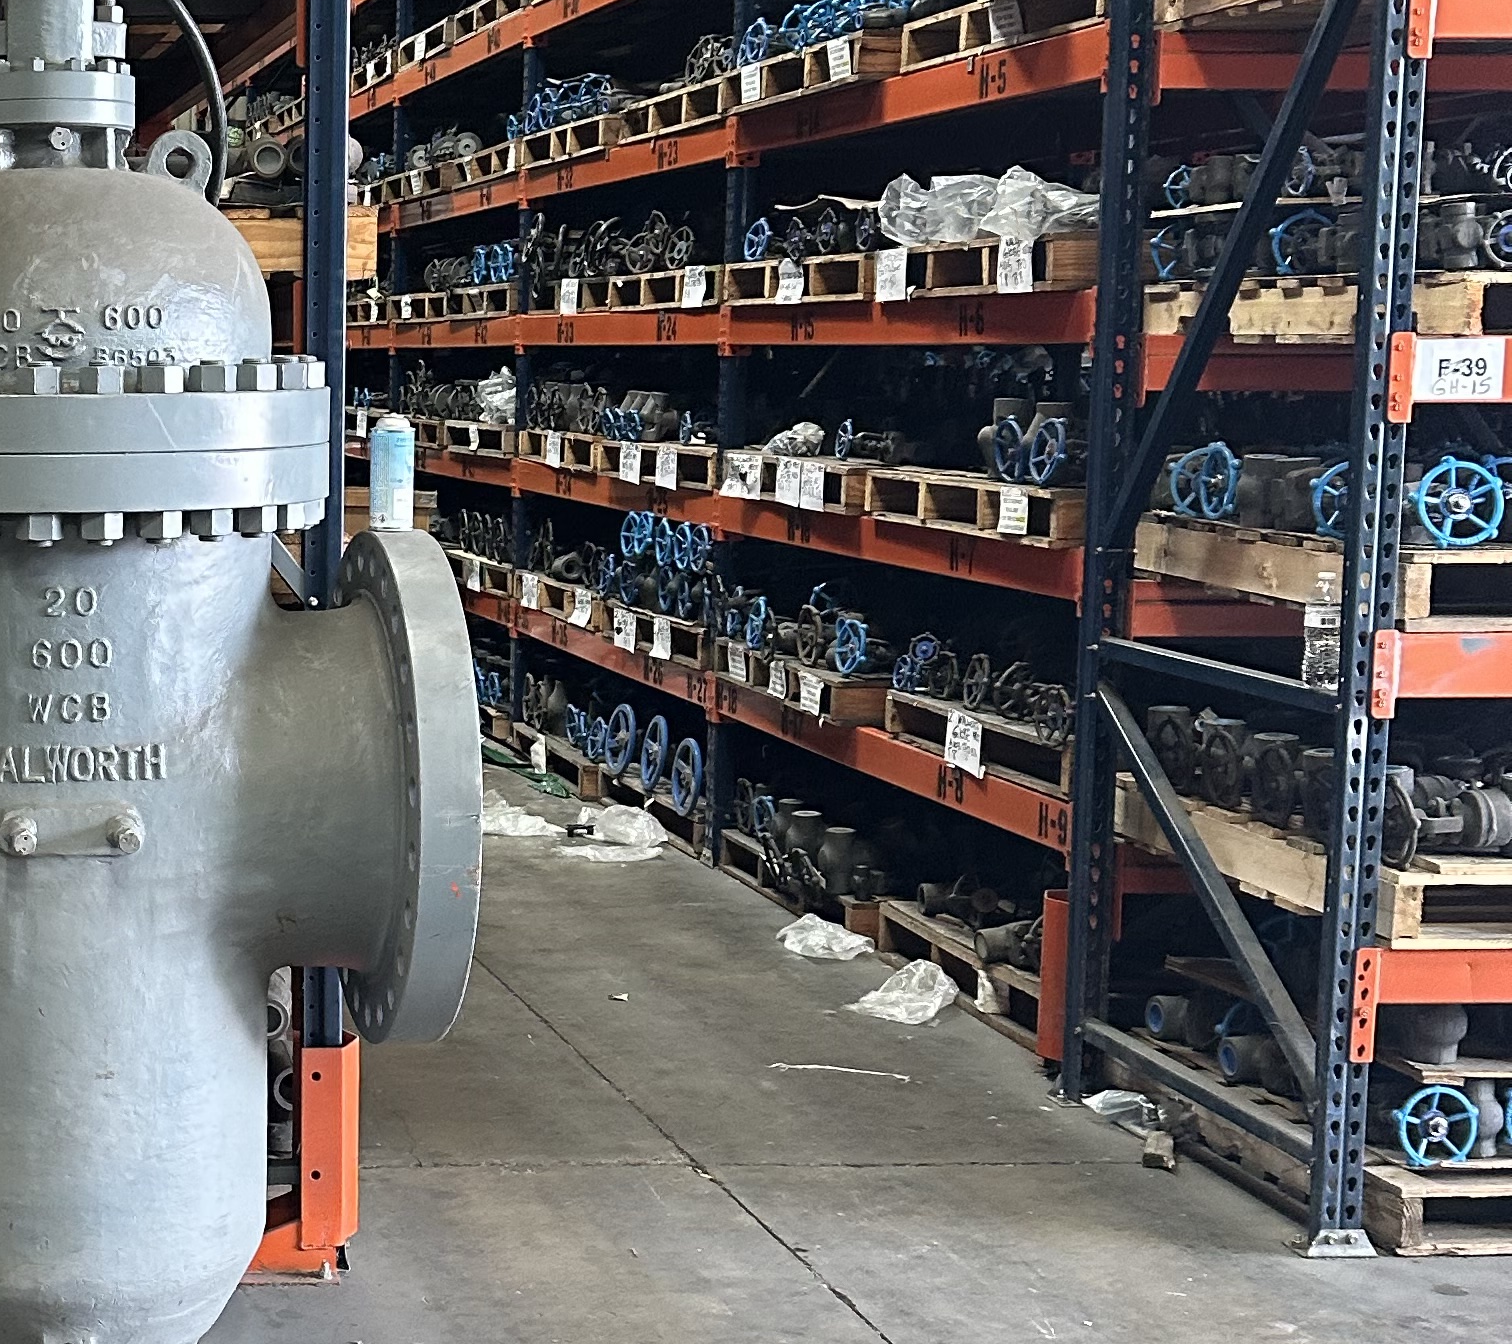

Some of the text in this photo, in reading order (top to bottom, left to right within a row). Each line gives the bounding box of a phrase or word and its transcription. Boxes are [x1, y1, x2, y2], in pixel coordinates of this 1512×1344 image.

[979, 58, 1007, 99] H-5
[102, 304, 165, 332] 600
[1437, 357, 1488, 378] F-39
[43, 583, 99, 619] 20
[30, 637, 114, 670] 600
[26, 691, 112, 725] WCB
[1037, 800, 1068, 846] H-9
